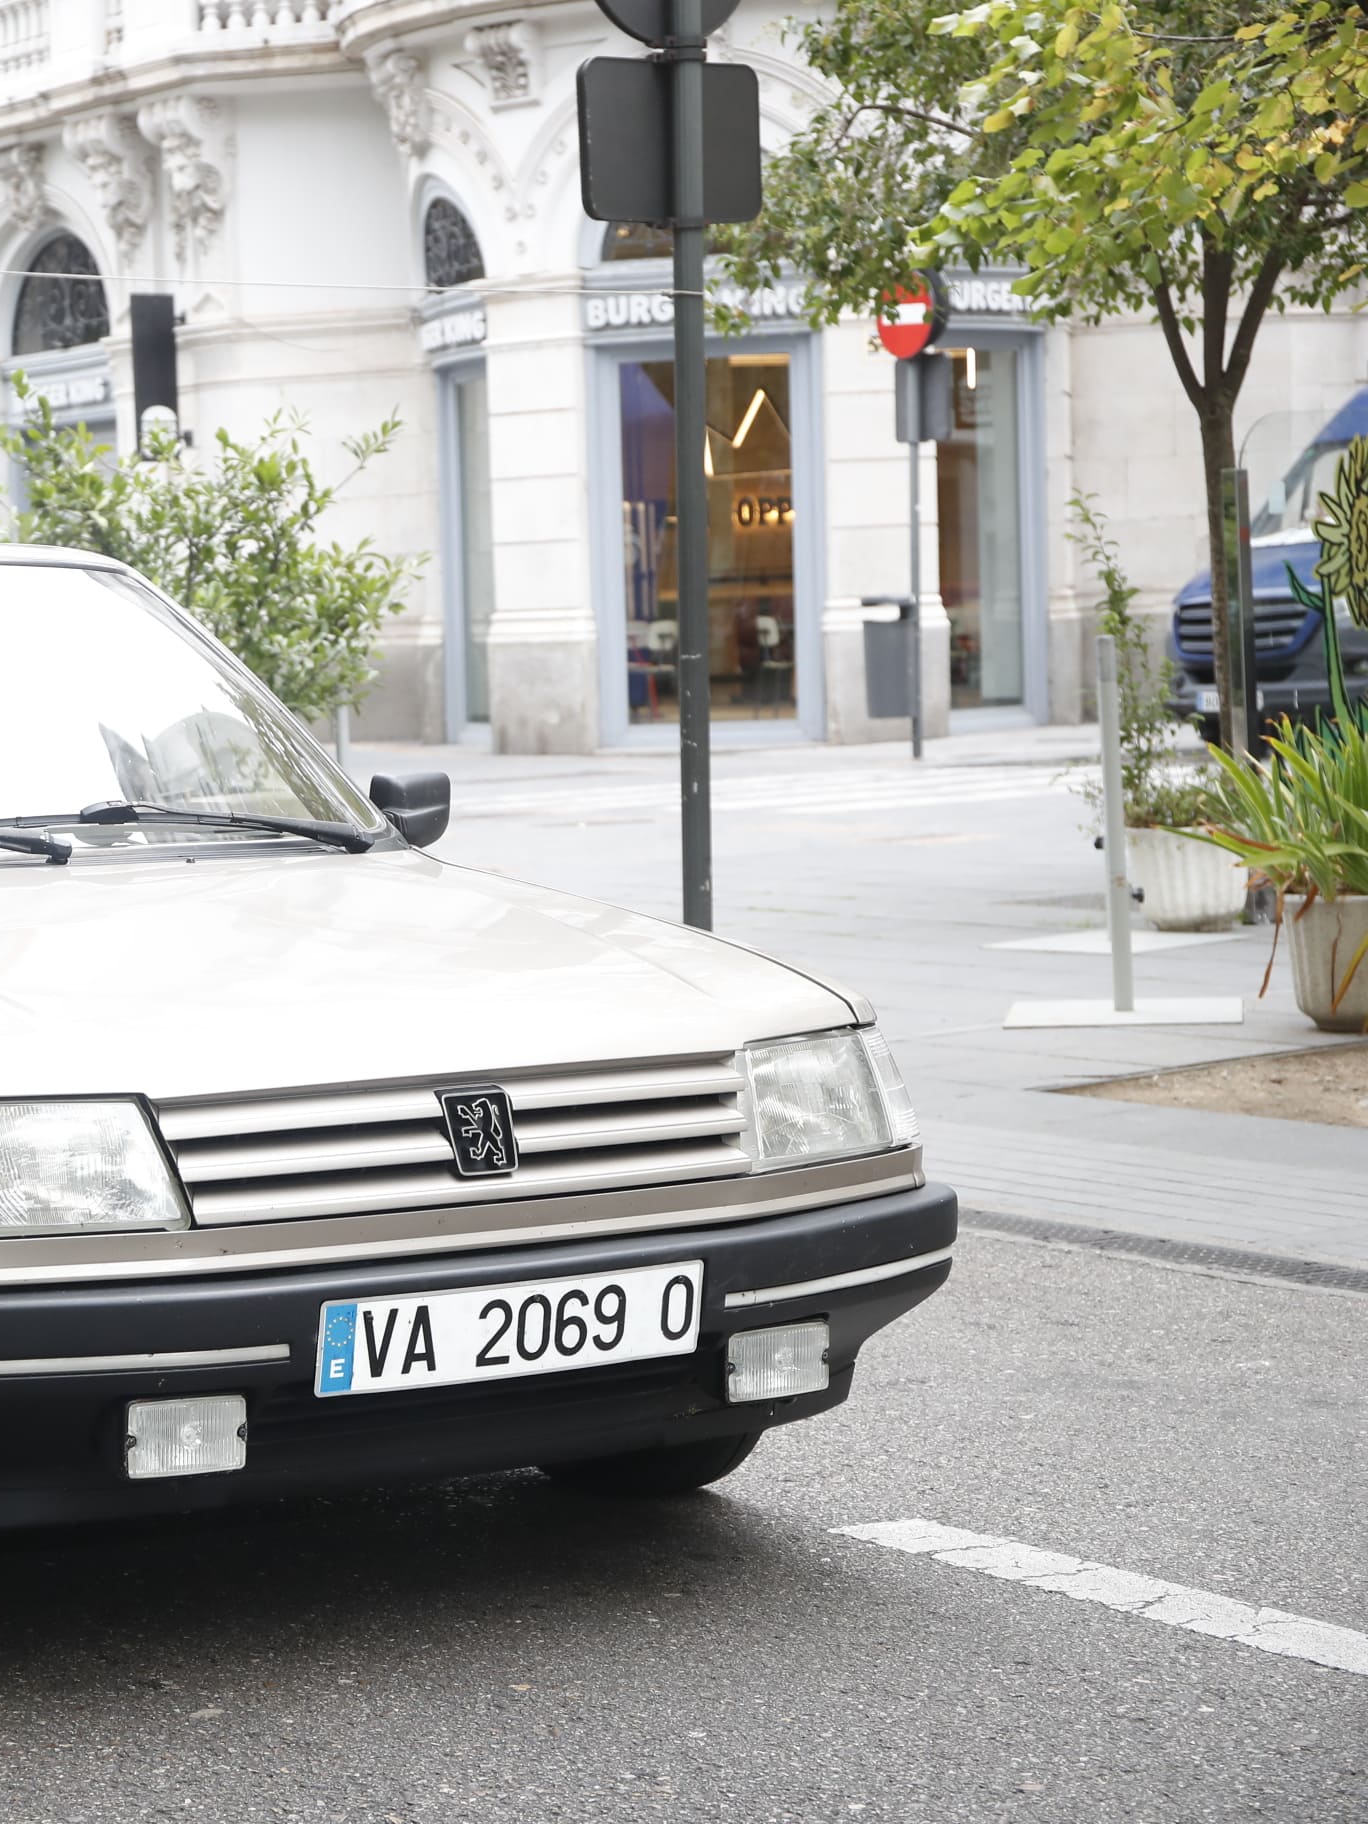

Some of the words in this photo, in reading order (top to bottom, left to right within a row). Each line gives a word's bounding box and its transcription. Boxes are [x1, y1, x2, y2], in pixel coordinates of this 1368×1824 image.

[587, 293, 674, 329] BURG
[948, 279, 1026, 311] URGE
[363, 1305, 437, 1378] VA
[475, 1284, 628, 1368] 2069
[329, 1358, 345, 1380] E
